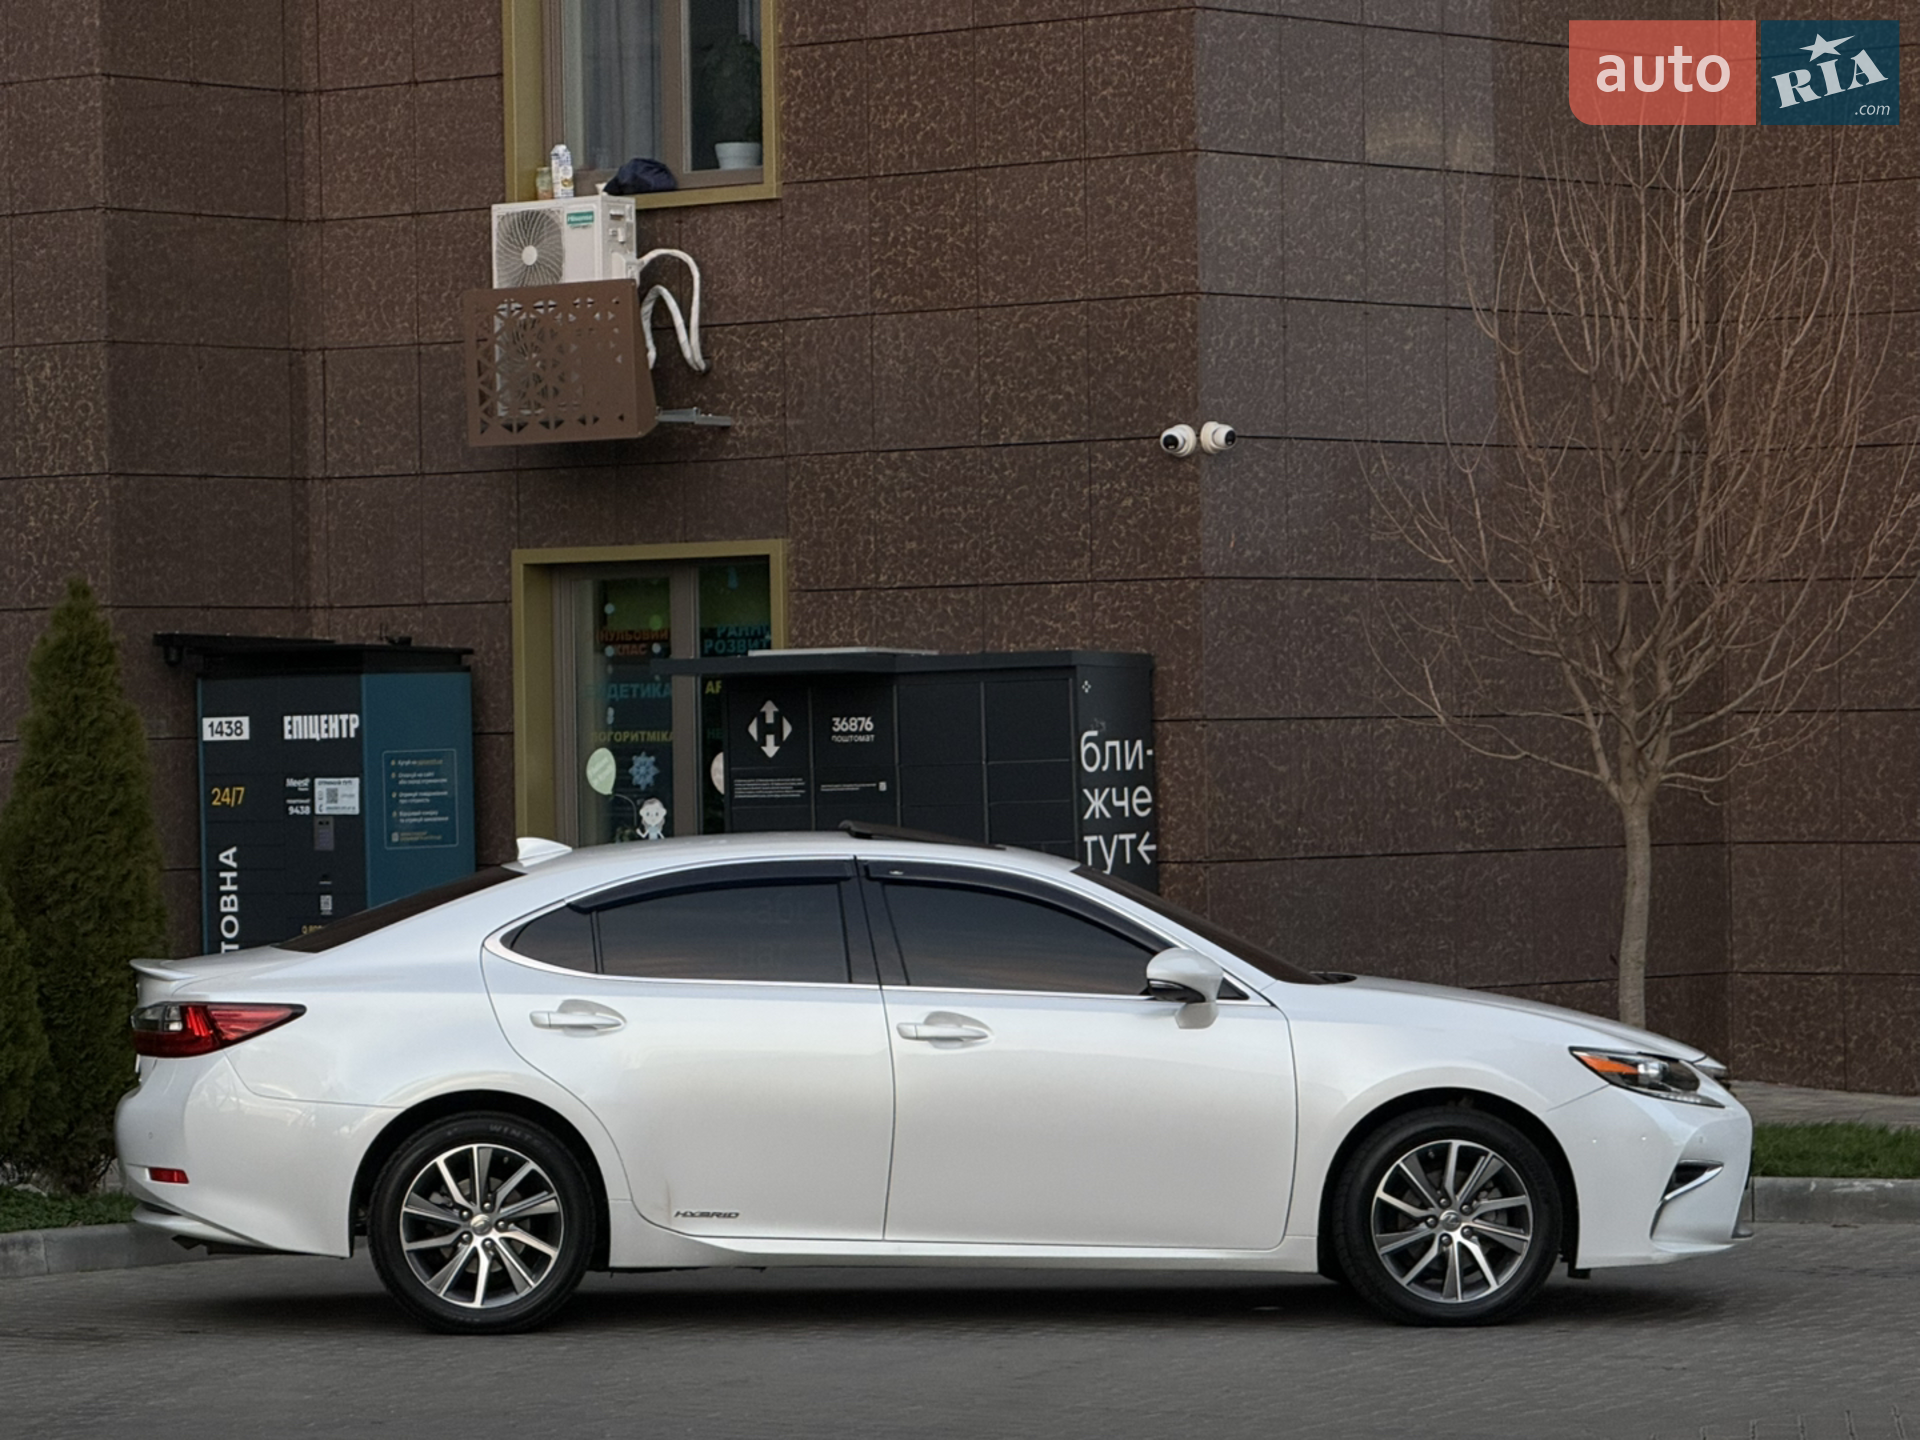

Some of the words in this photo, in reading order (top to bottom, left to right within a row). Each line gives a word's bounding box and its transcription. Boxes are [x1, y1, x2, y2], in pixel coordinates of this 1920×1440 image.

[208, 720, 244, 737] 1438
[283, 714, 360, 741] ЕПІЦЕНТР
[832, 716, 874, 732] 36876
[211, 786, 245, 808] 24/7
[1083, 785, 1153, 820] жче
[674, 1210, 740, 1219] HYBRID
